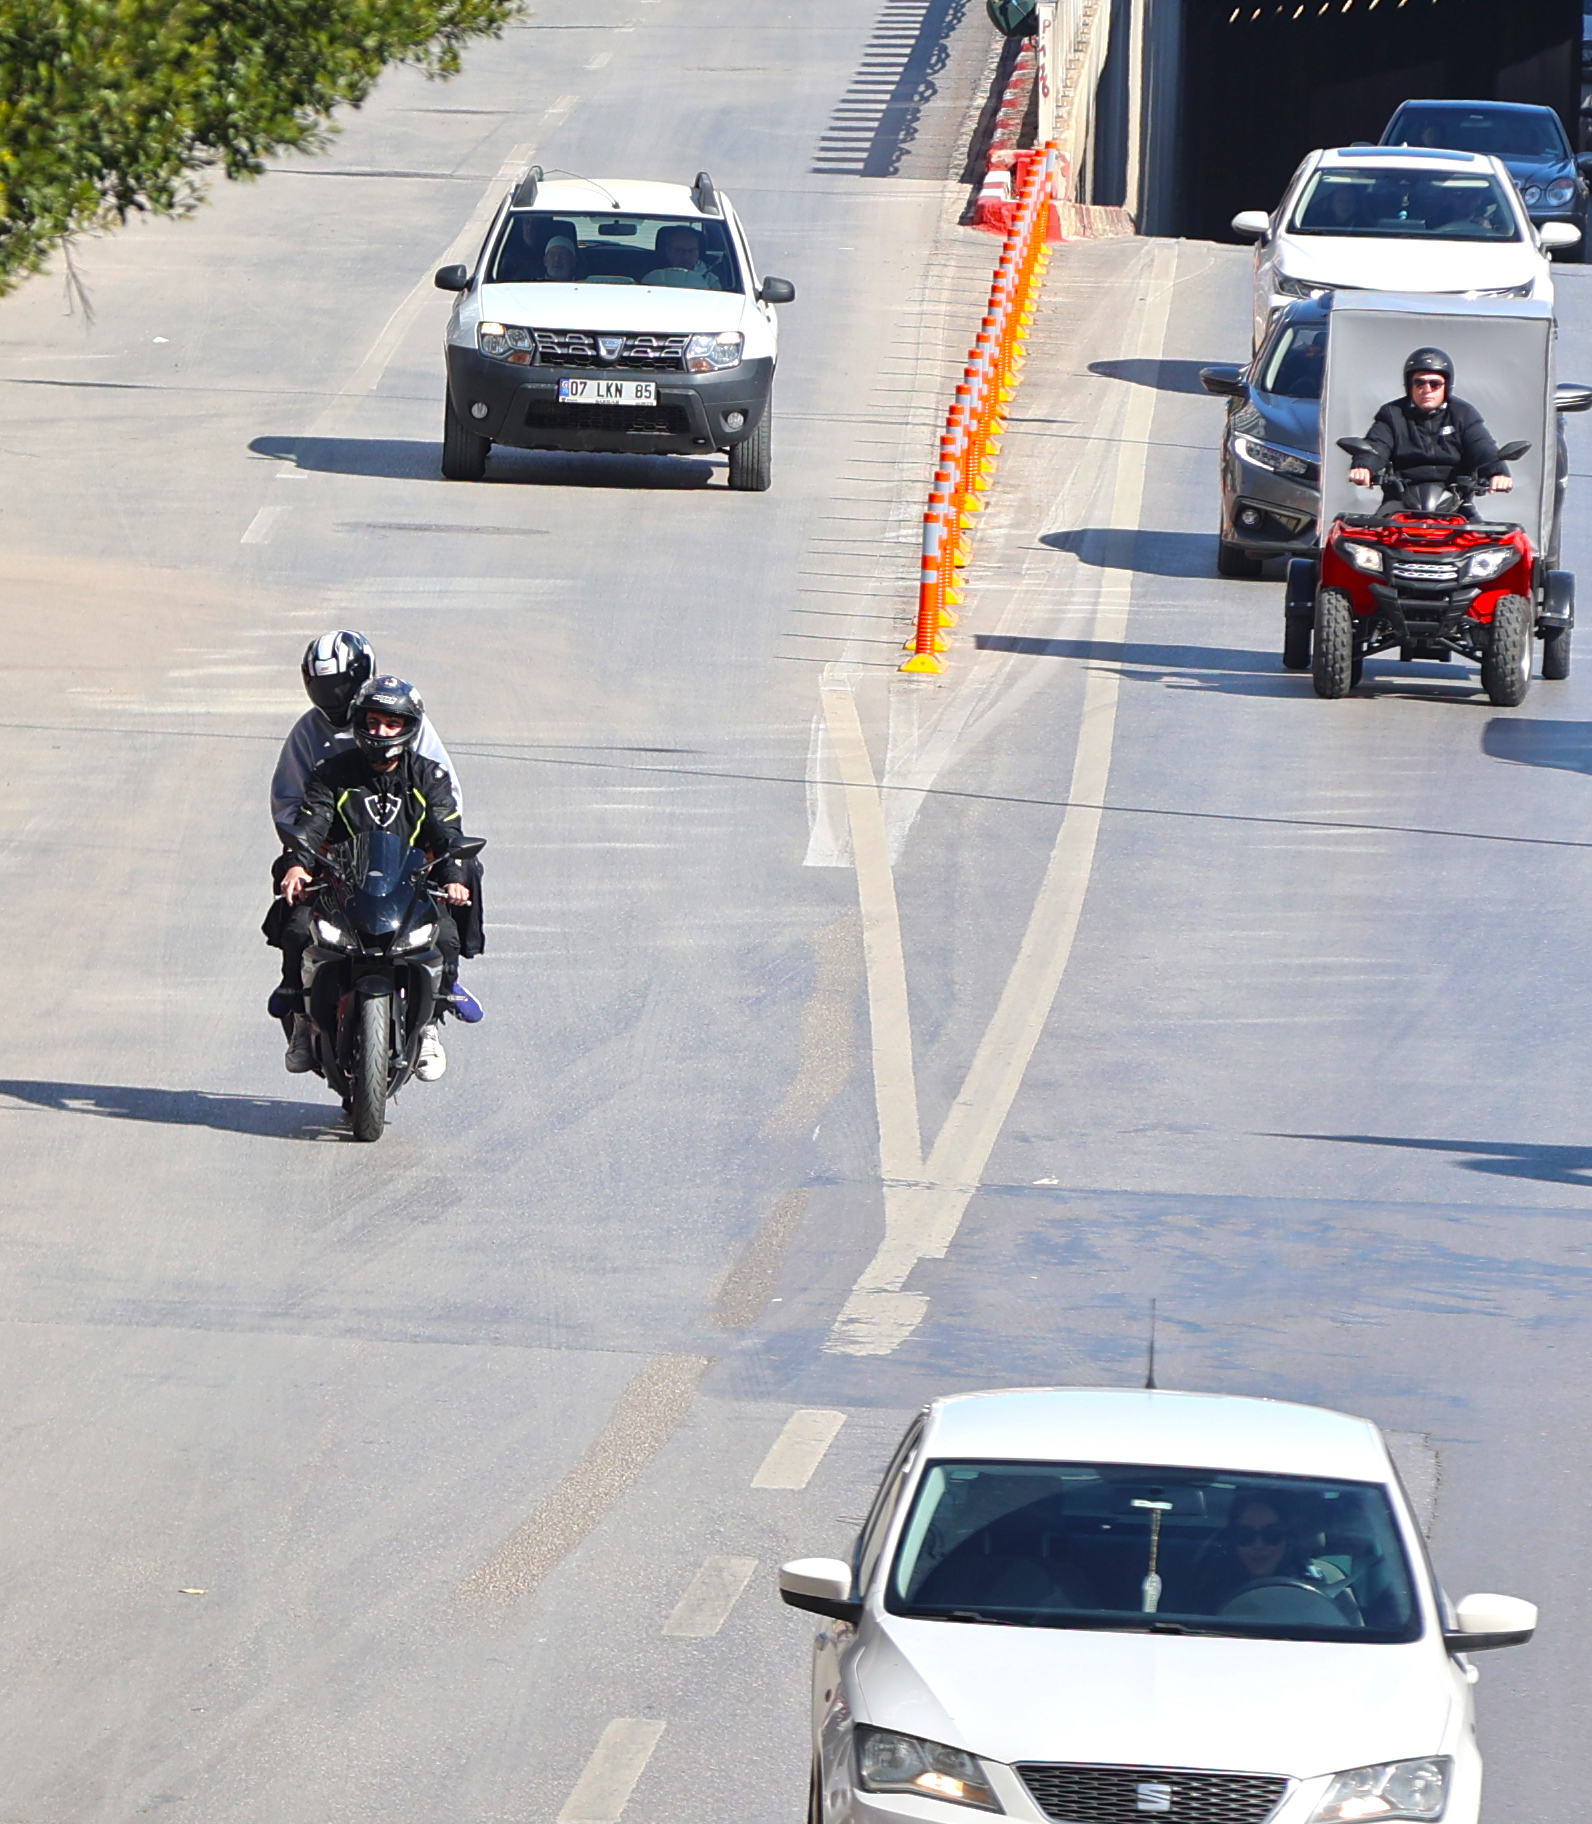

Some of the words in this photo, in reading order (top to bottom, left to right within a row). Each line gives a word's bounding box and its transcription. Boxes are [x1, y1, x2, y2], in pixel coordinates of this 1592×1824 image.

[570, 381, 588, 396] 07
[596, 382, 624, 399] LKN
[634, 383, 652, 399] 85
